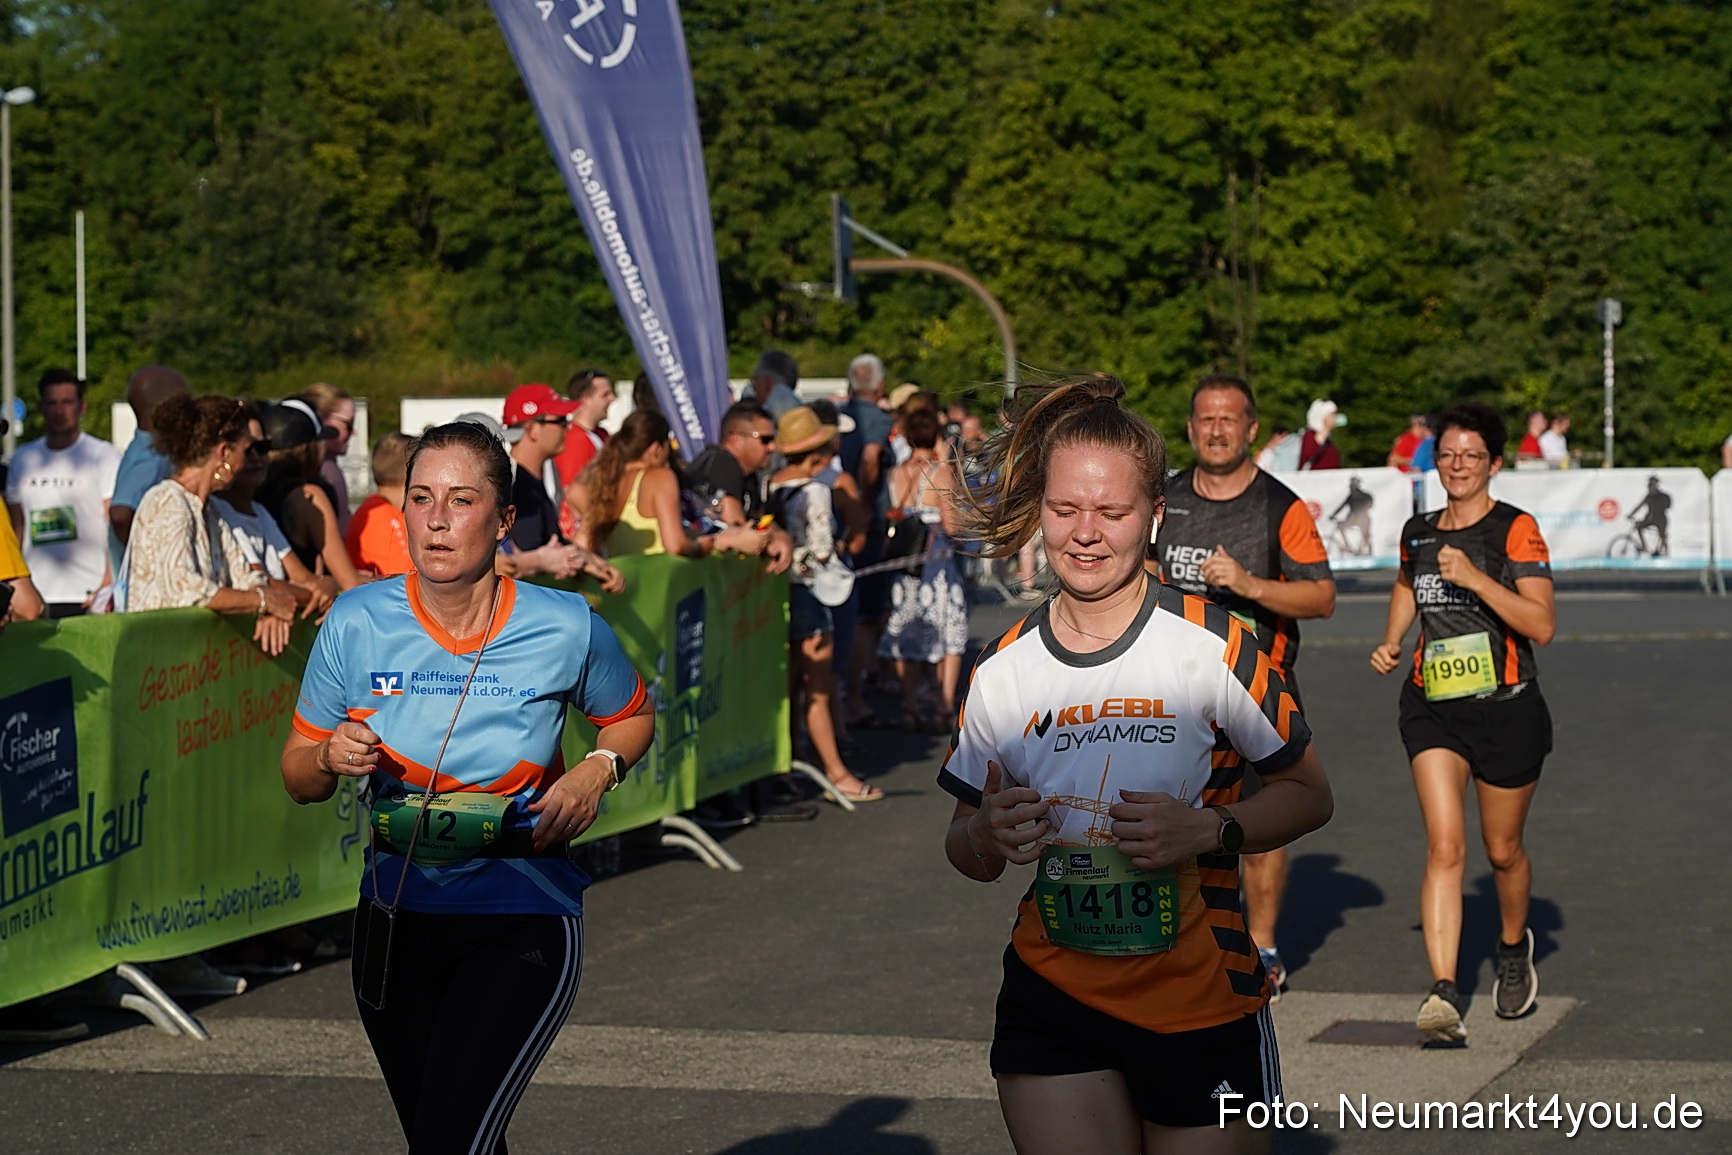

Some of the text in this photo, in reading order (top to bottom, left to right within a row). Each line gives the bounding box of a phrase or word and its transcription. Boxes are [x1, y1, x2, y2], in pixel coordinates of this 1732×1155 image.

[139, 637, 222, 711] Gesunde
[1429, 656, 1480, 681] 1990
[410, 685, 536, 698] Neumarkt i.d.OPf. eG
[237, 682, 297, 737] länger
[1056, 698, 1177, 728] KLEBL
[11, 727, 61, 762] Fischer
[177, 698, 234, 759] laufen
[1053, 724, 1177, 752] DYNAMICS
[0, 769, 149, 906] rmenlauf
[417, 808, 457, 842] 12
[1065, 865, 1110, 876] Firmenlauf
[0, 892, 54, 940] umarkt
[1044, 894, 1060, 930] RUN
[1058, 881, 1155, 919] 1418
[1158, 885, 1173, 936] 2022
[1073, 922, 1142, 935] Nutz Maria
[519, 954, 548, 968] adidas
